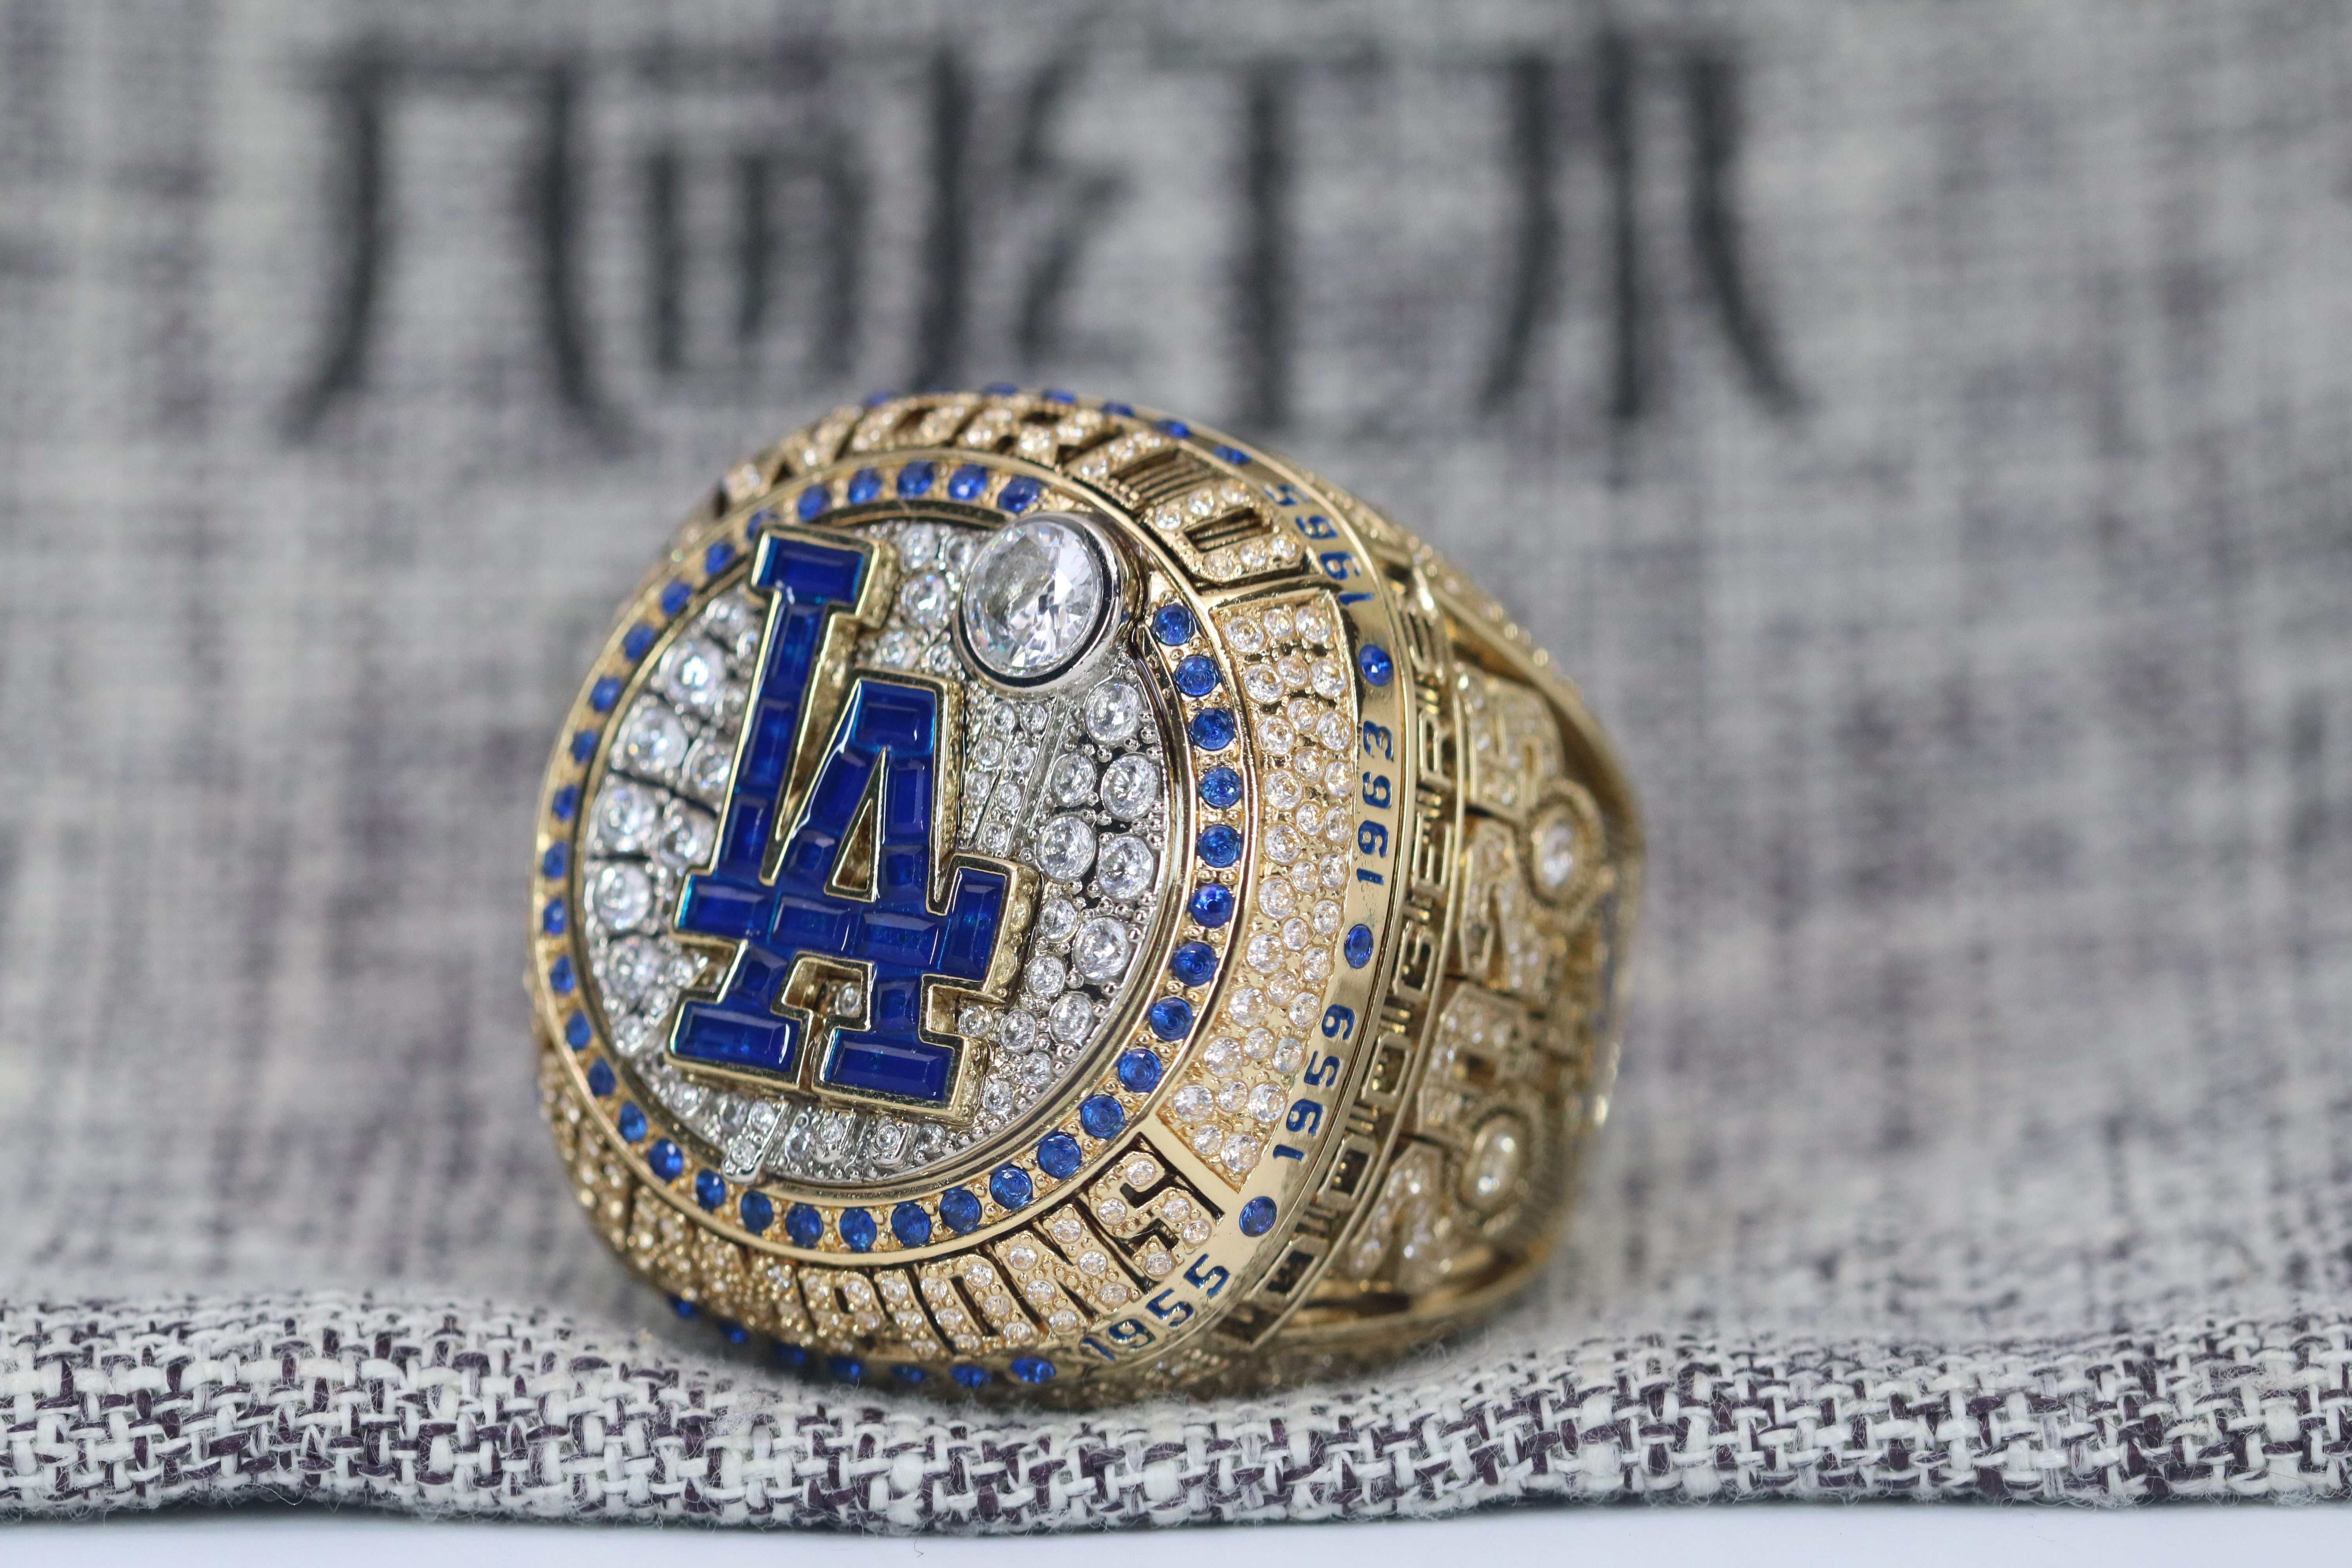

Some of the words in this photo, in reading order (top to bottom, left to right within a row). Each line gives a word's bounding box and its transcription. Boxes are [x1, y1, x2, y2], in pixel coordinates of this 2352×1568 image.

[1262, 484, 1374, 607] 1965
[664, 524, 1035, 1119] LA
[1356, 720, 1394, 886] 1963
[1272, 1004, 1356, 1162] 1959
[1080, 1253, 1231, 1362] 1955
